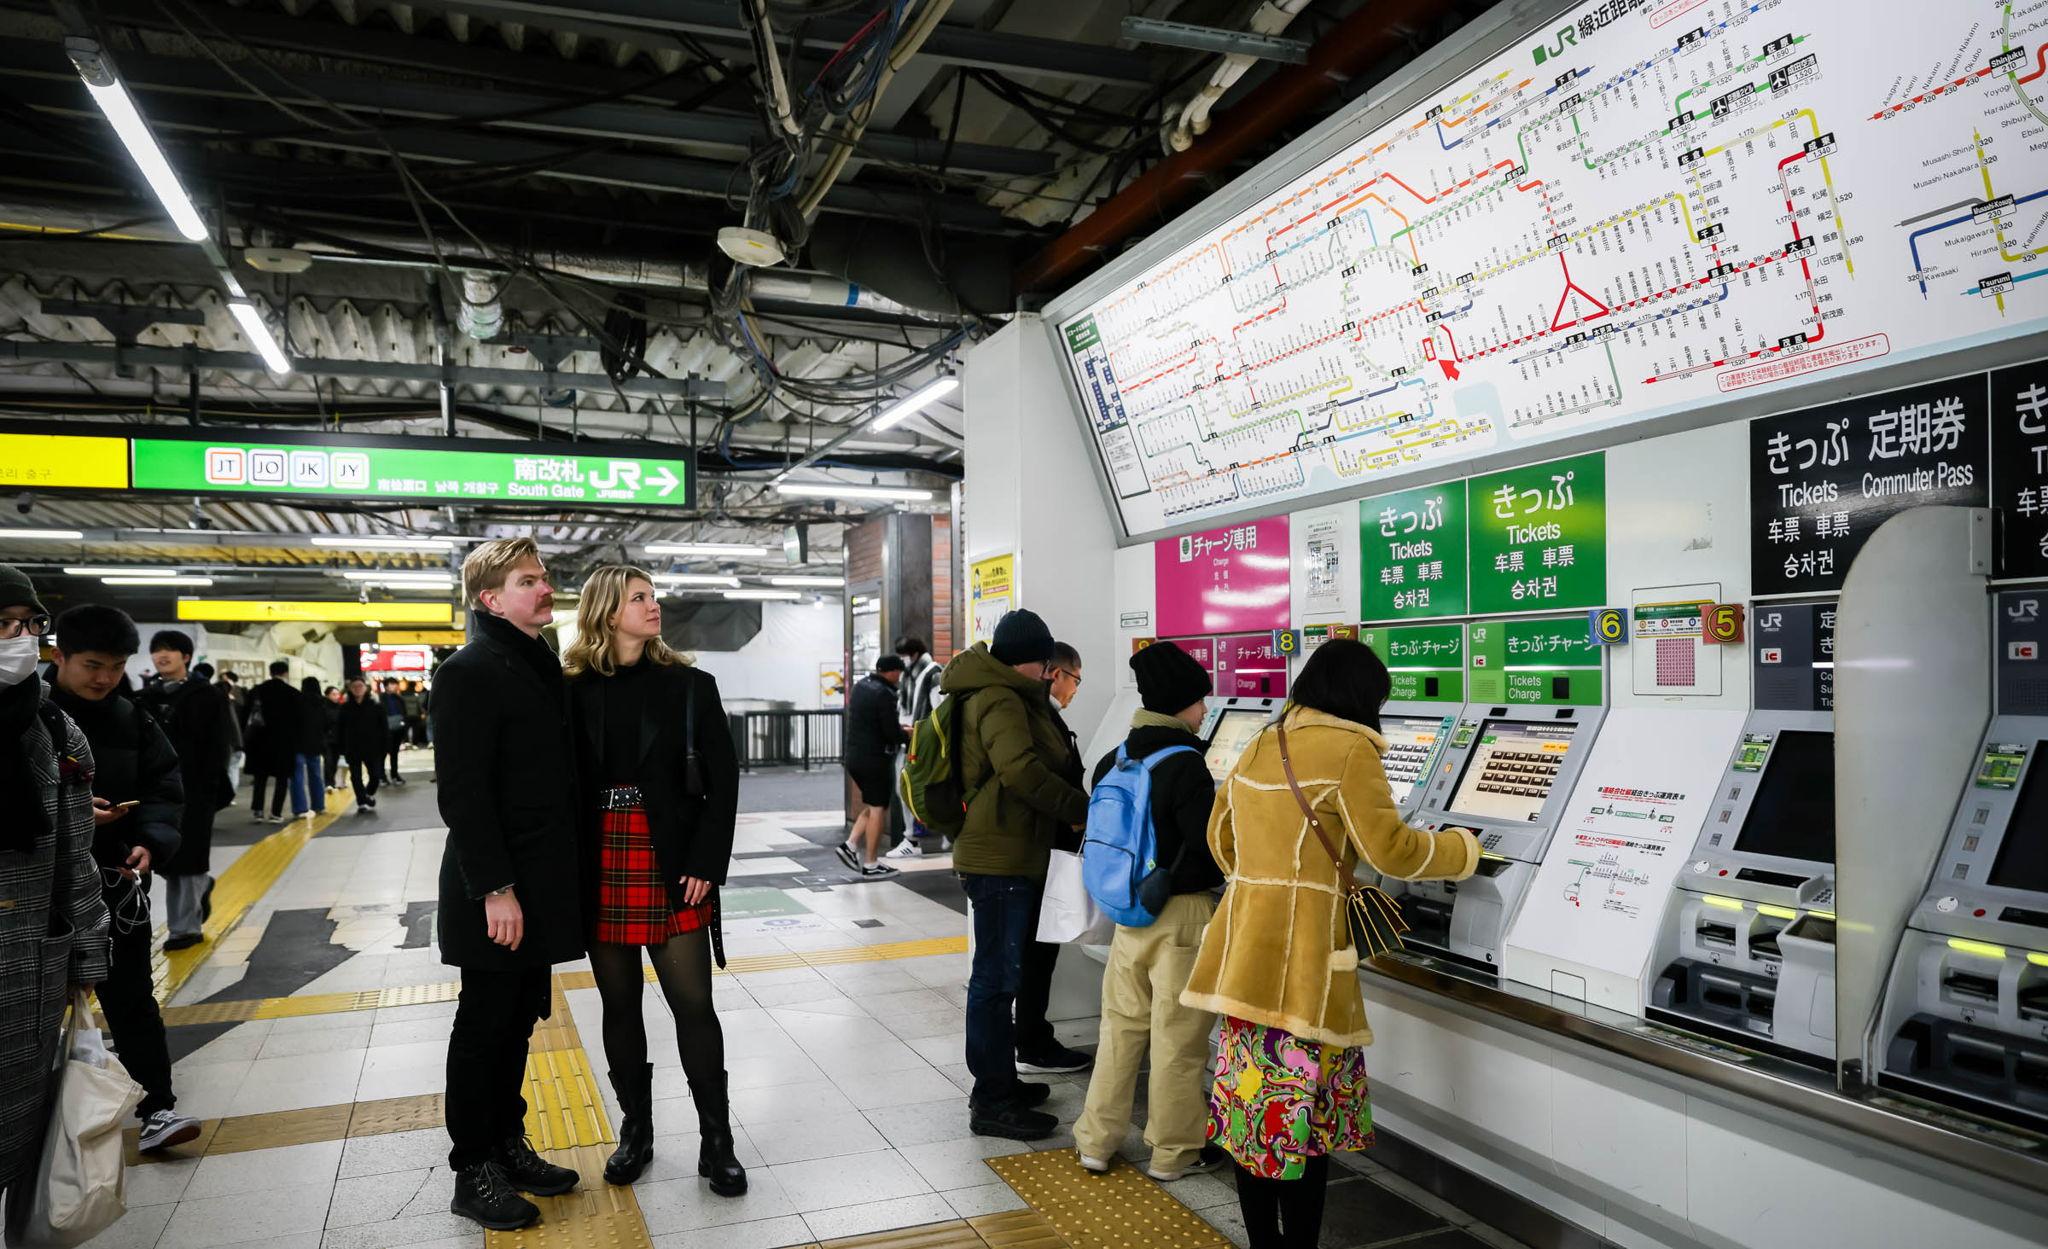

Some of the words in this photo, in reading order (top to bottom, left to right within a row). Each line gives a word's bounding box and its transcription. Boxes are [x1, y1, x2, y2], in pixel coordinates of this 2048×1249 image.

[1990, 27, 2005, 38] 210
[1548, 25, 1578, 57] JR
[1772, 47, 1789, 60] 1,690
[1990, 50, 2024, 68] Shinjuku
[1964, 48, 1982, 73] Okubo
[2002, 61, 2017, 72] 210
[1795, 67, 1813, 80] 1,520
[1922, 61, 1942, 90] Nakano
[1965, 76, 1980, 87] 230
[1883, 75, 1902, 106] Asagaya
[1944, 85, 1957, 96] 230
[1984, 84, 2011, 98] Yoyogi
[1923, 94, 1936, 105] 320
[2029, 96, 2044, 106] 210
[1903, 102, 1916, 113] 320
[1984, 100, 2021, 116] Harajuku
[1781, 108, 1799, 120] 1,340
[1884, 111, 1896, 120] 320
[2001, 112, 2033, 128] Shibuya
[1739, 128, 1755, 139] 1,170
[2021, 126, 2044, 138] Ebisu
[1980, 136, 1994, 147] 320
[1813, 147, 1831, 158] 1,340
[1688, 161, 1698, 170] 990
[1984, 155, 1998, 165] 320
[1768, 183, 1784, 195] 1,340
[1835, 192, 1853, 203] 1,520
[1696, 216, 1707, 224] 770
[1775, 214, 1792, 225] 1,170
[1988, 210, 2002, 219] 230
[1999, 221, 2013, 231] 320
[1845, 235, 1864, 246] 1,690
[1944, 227, 1995, 248] Mukaigawara
[2002, 239, 2017, 249] 320
[1705, 253, 1717, 261] 770
[1770, 249, 1782, 258] 990
[1794, 248, 1810, 258] 1,170
[1971, 245, 1999, 258] Hirama
[1754, 254, 1765, 263] 990
[2022, 254, 2037, 263] 320
[1908, 274, 1920, 282] 320
[1925, 266, 1959, 281] Kawasaki
[1981, 275, 2010, 288] Tsurumi
[1991, 284, 2005, 293] 320
[1795, 290, 1812, 300] 1,170
[1801, 316, 1818, 326] 1,340
[1786, 344, 1803, 354] 1,340
[1730, 358, 1746, 366] 1,520
[1767, 417, 1850, 475] きっぷ
[1868, 396, 1966, 461] 定期券
[514, 458, 584, 482] 南改札
[508, 483, 547, 497] South
[552, 484, 584, 497] Gate
[1779, 480, 1838, 508] Tickets
[1862, 468, 1935, 498] Commuter
[1938, 461, 1974, 488] Pass
[1494, 471, 1574, 519] きっぷ
[1379, 496, 1443, 537] きっぷ
[1768, 516, 1800, 544] 车票
[1816, 510, 1850, 539] 車票
[1506, 522, 1561, 545] Tickets
[1194, 526, 1256, 557] チャージ専用
[1390, 540, 1432, 560] Tickets
[1495, 551, 1523, 573] 车票
[1543, 545, 1574, 568] 車票
[1784, 548, 1834, 579] 승차권
[1381, 566, 1404, 585] 车票
[1418, 561, 1443, 581] 車票
[1511, 576, 1557, 600] 승차권
[1393, 588, 1430, 609] 승차권
[2008, 599, 2039, 617] JR
[1602, 613, 1621, 638] 6
[1715, 610, 1735, 636] 5
[1760, 613, 1782, 627] JR
[1473, 628, 1486, 640] JR
[1280, 633, 1294, 651] 8
[1391, 676, 1416, 685] Tickets
[1508, 675, 1541, 686] Tickets
[1820, 672, 1832, 680] Co
[1237, 679, 1256, 689] Charge
[1820, 684, 1833, 693] Su
[1391, 687, 1416, 699] Charge
[1509, 688, 1541, 702] Charge
